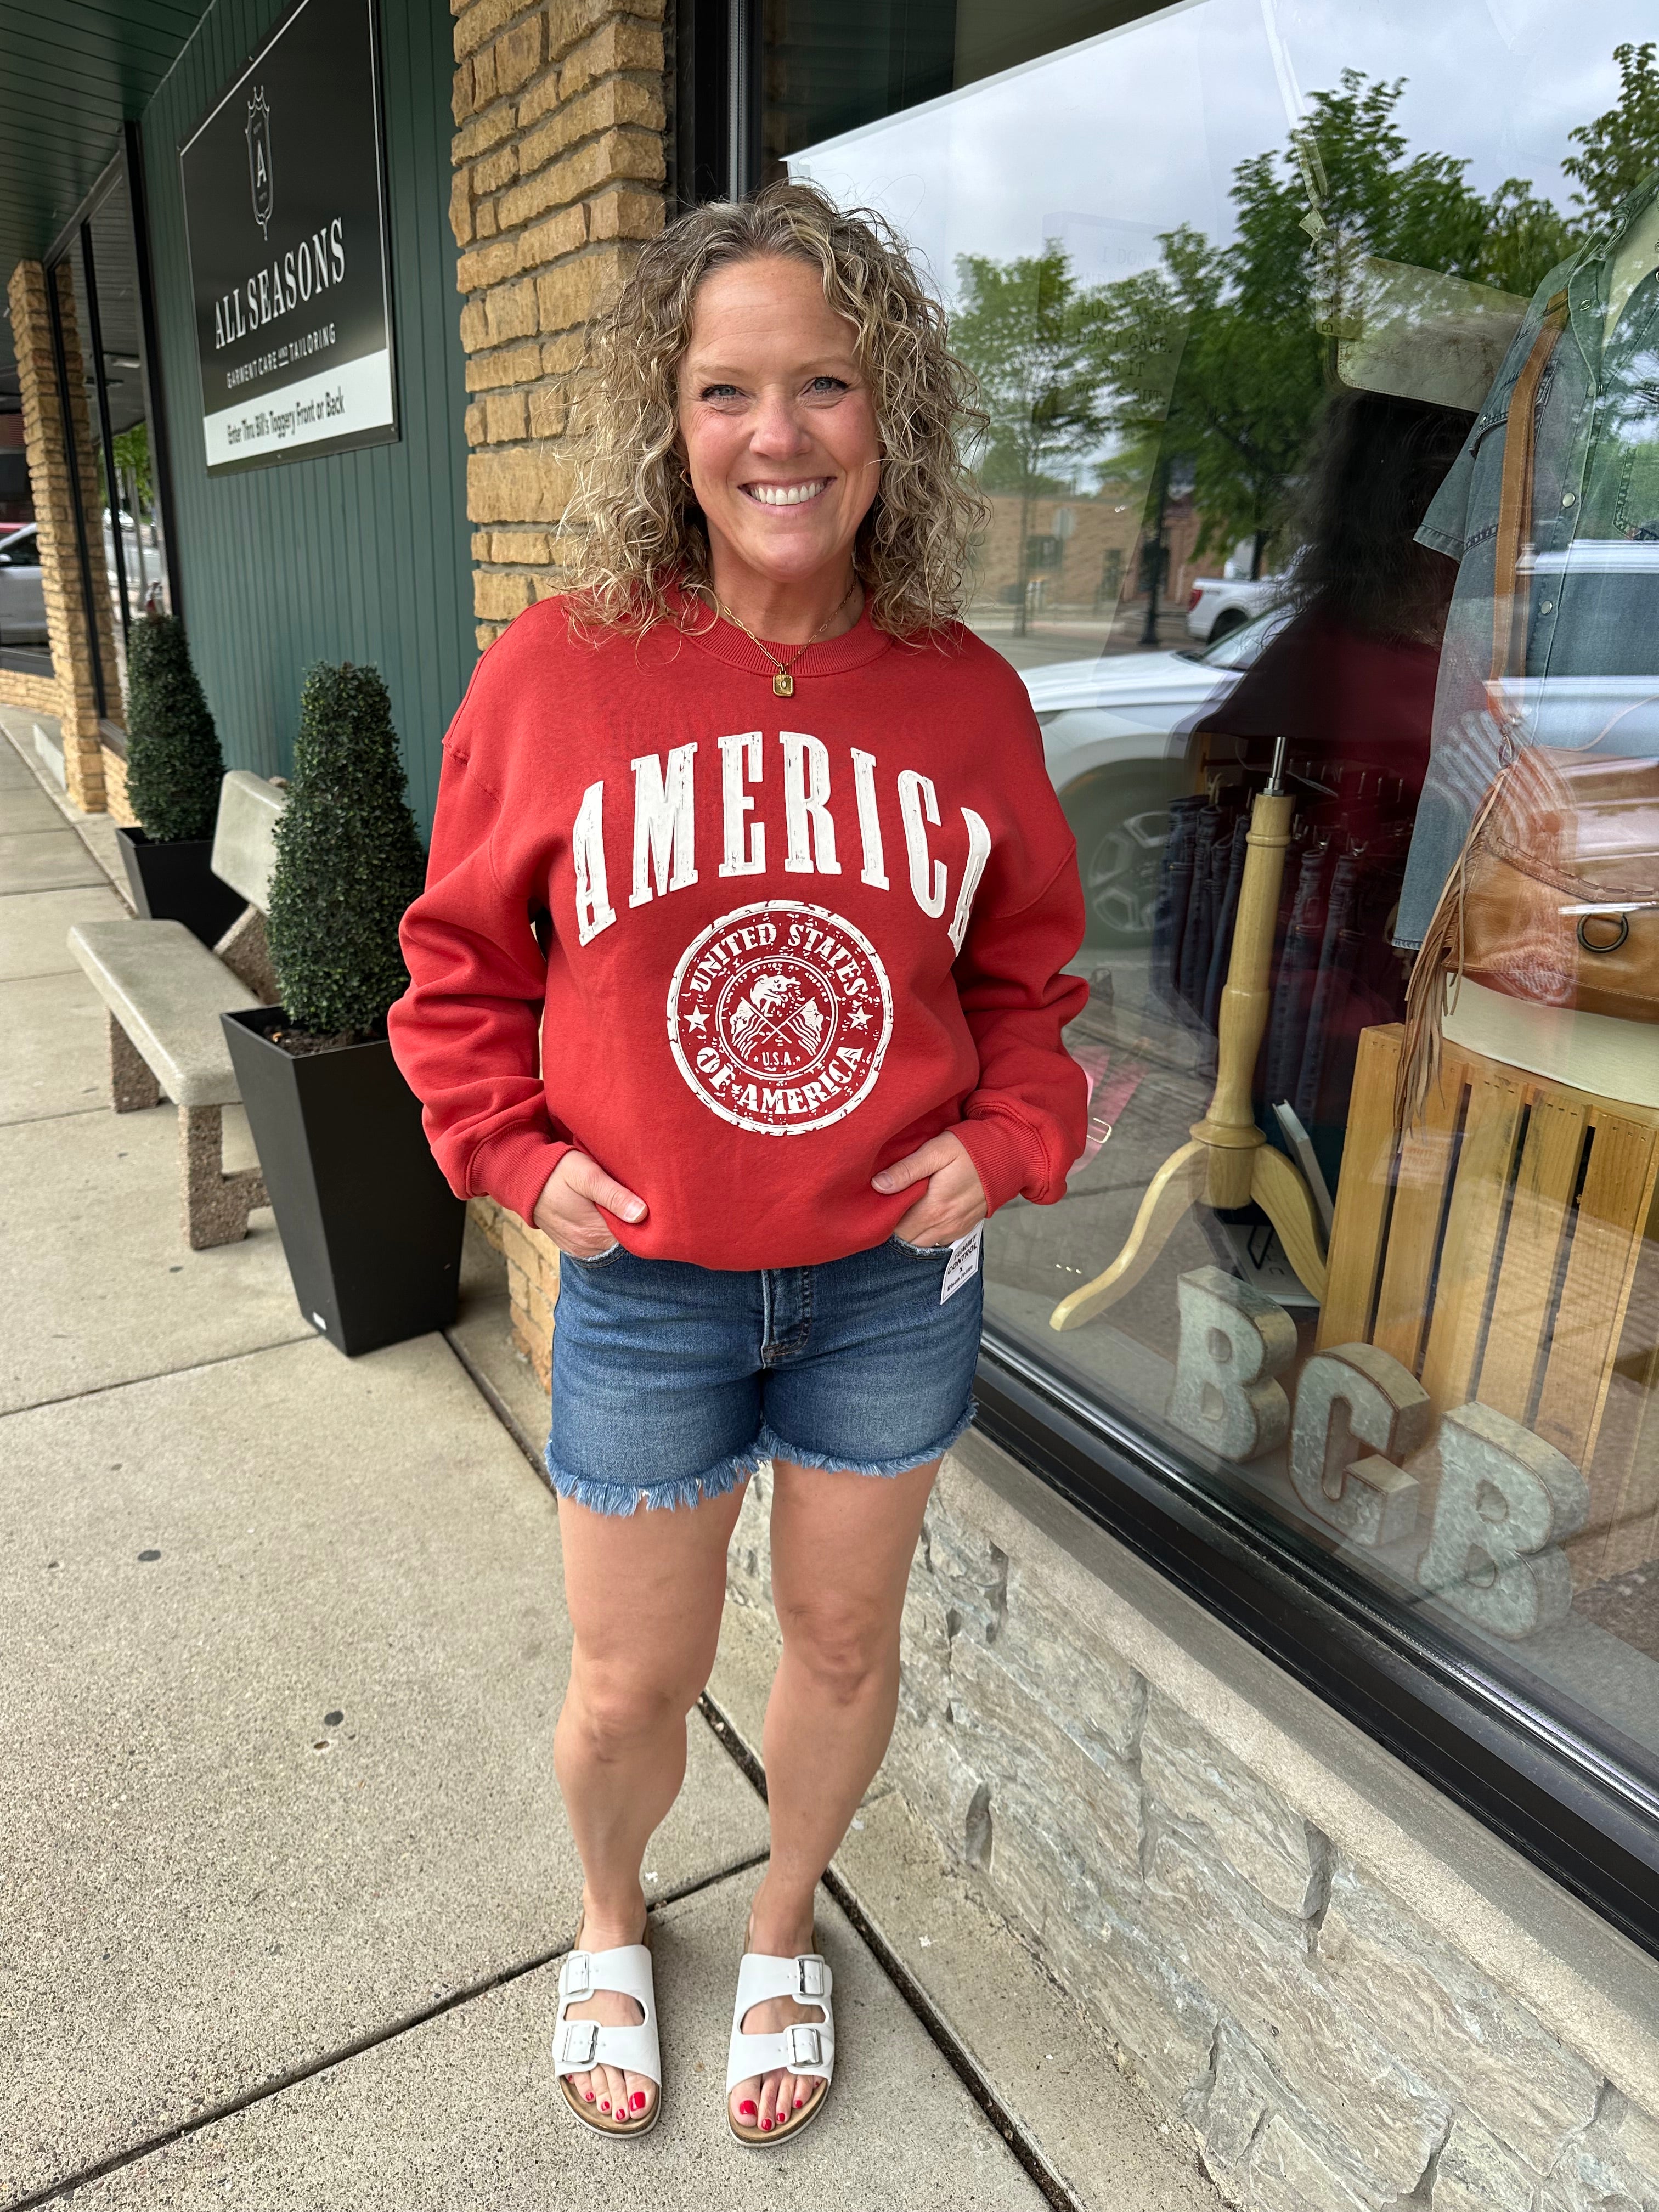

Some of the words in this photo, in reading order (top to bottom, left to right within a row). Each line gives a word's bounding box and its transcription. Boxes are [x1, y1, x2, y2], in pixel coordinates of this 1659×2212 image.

[257, 140, 267, 188] A
[216, 289, 246, 349] ALL
[247, 217, 345, 330] SEASONS
[227, 360, 258, 389] GARMENT
[258, 351, 278, 375] CARE
[289, 323, 336, 362] TAILORING
[1128, 360, 1145, 377] IT
[241, 418, 255, 441] Thru
[255, 411, 269, 437] Bill's
[269, 410, 295, 439] Toggery
[296, 399, 316, 426] Front
[316, 401, 324, 421] or
[325, 386, 345, 418] Back
[690, 922, 777, 993] UNITED
[788, 923, 868, 996] STATES
[696, 1046, 737, 1091] OF
[737, 1046, 865, 1115] AMERICA
[761, 1051, 796, 1066] U.S.A.
[947, 1242, 977, 1275] CONTROL
[953, 1233, 977, 1261] TUMMY
[947, 1277, 960, 1291] Risen
[961, 1264, 973, 1279] Jeans
